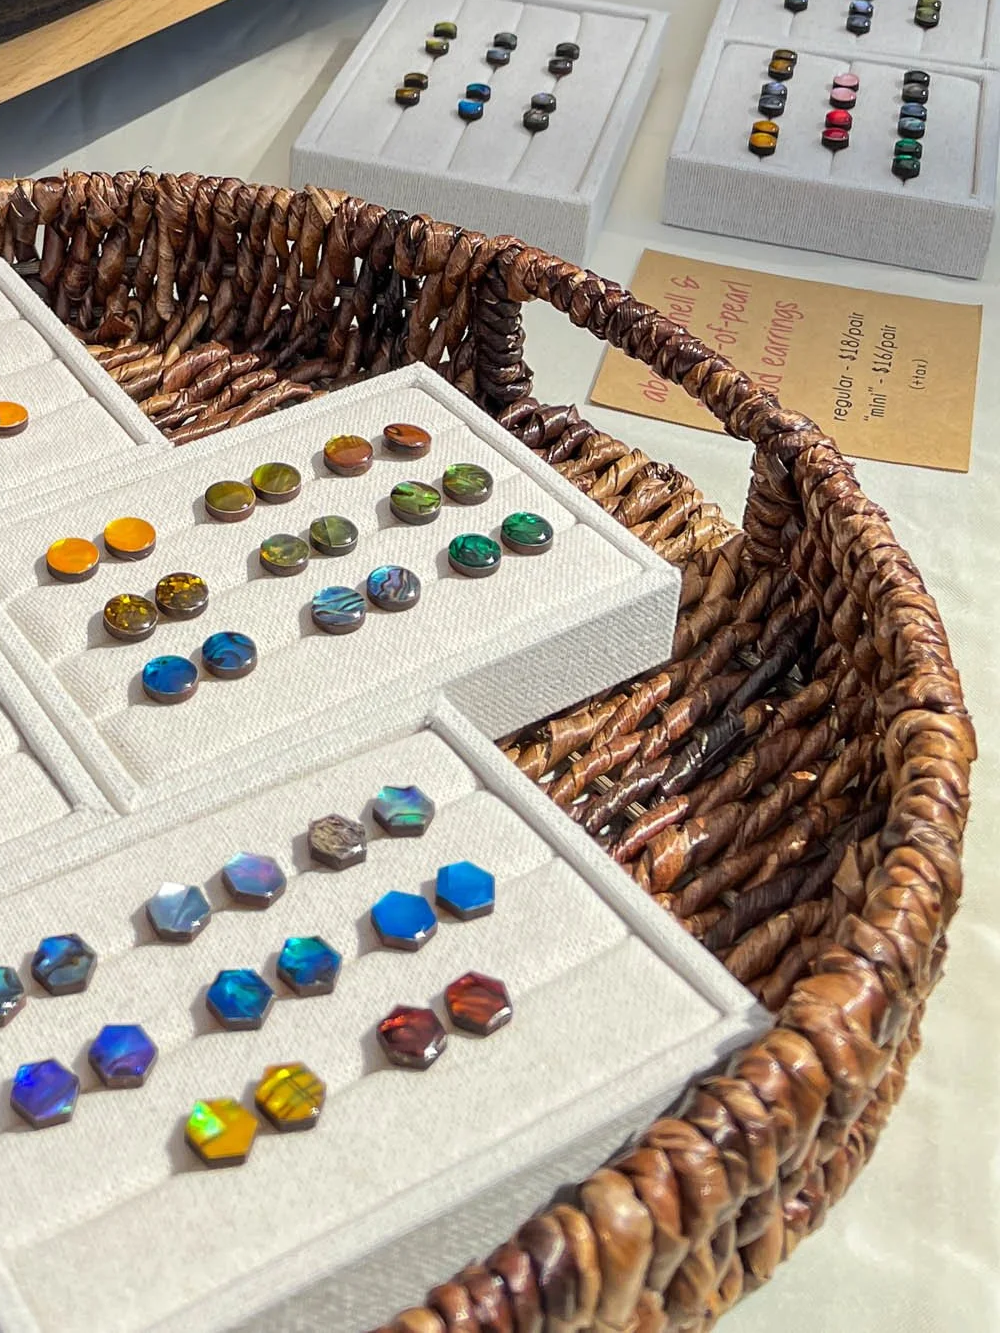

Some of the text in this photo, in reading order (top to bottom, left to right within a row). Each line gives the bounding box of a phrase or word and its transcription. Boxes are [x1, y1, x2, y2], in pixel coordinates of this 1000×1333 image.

[761, 301, 804, 367] earrings
[838, 312, 864, 361] $18/pair
[871, 324, 898, 374] $16/pair
[832, 374, 854, 422] regular
[907, 358, 928, 390] (+tax)
